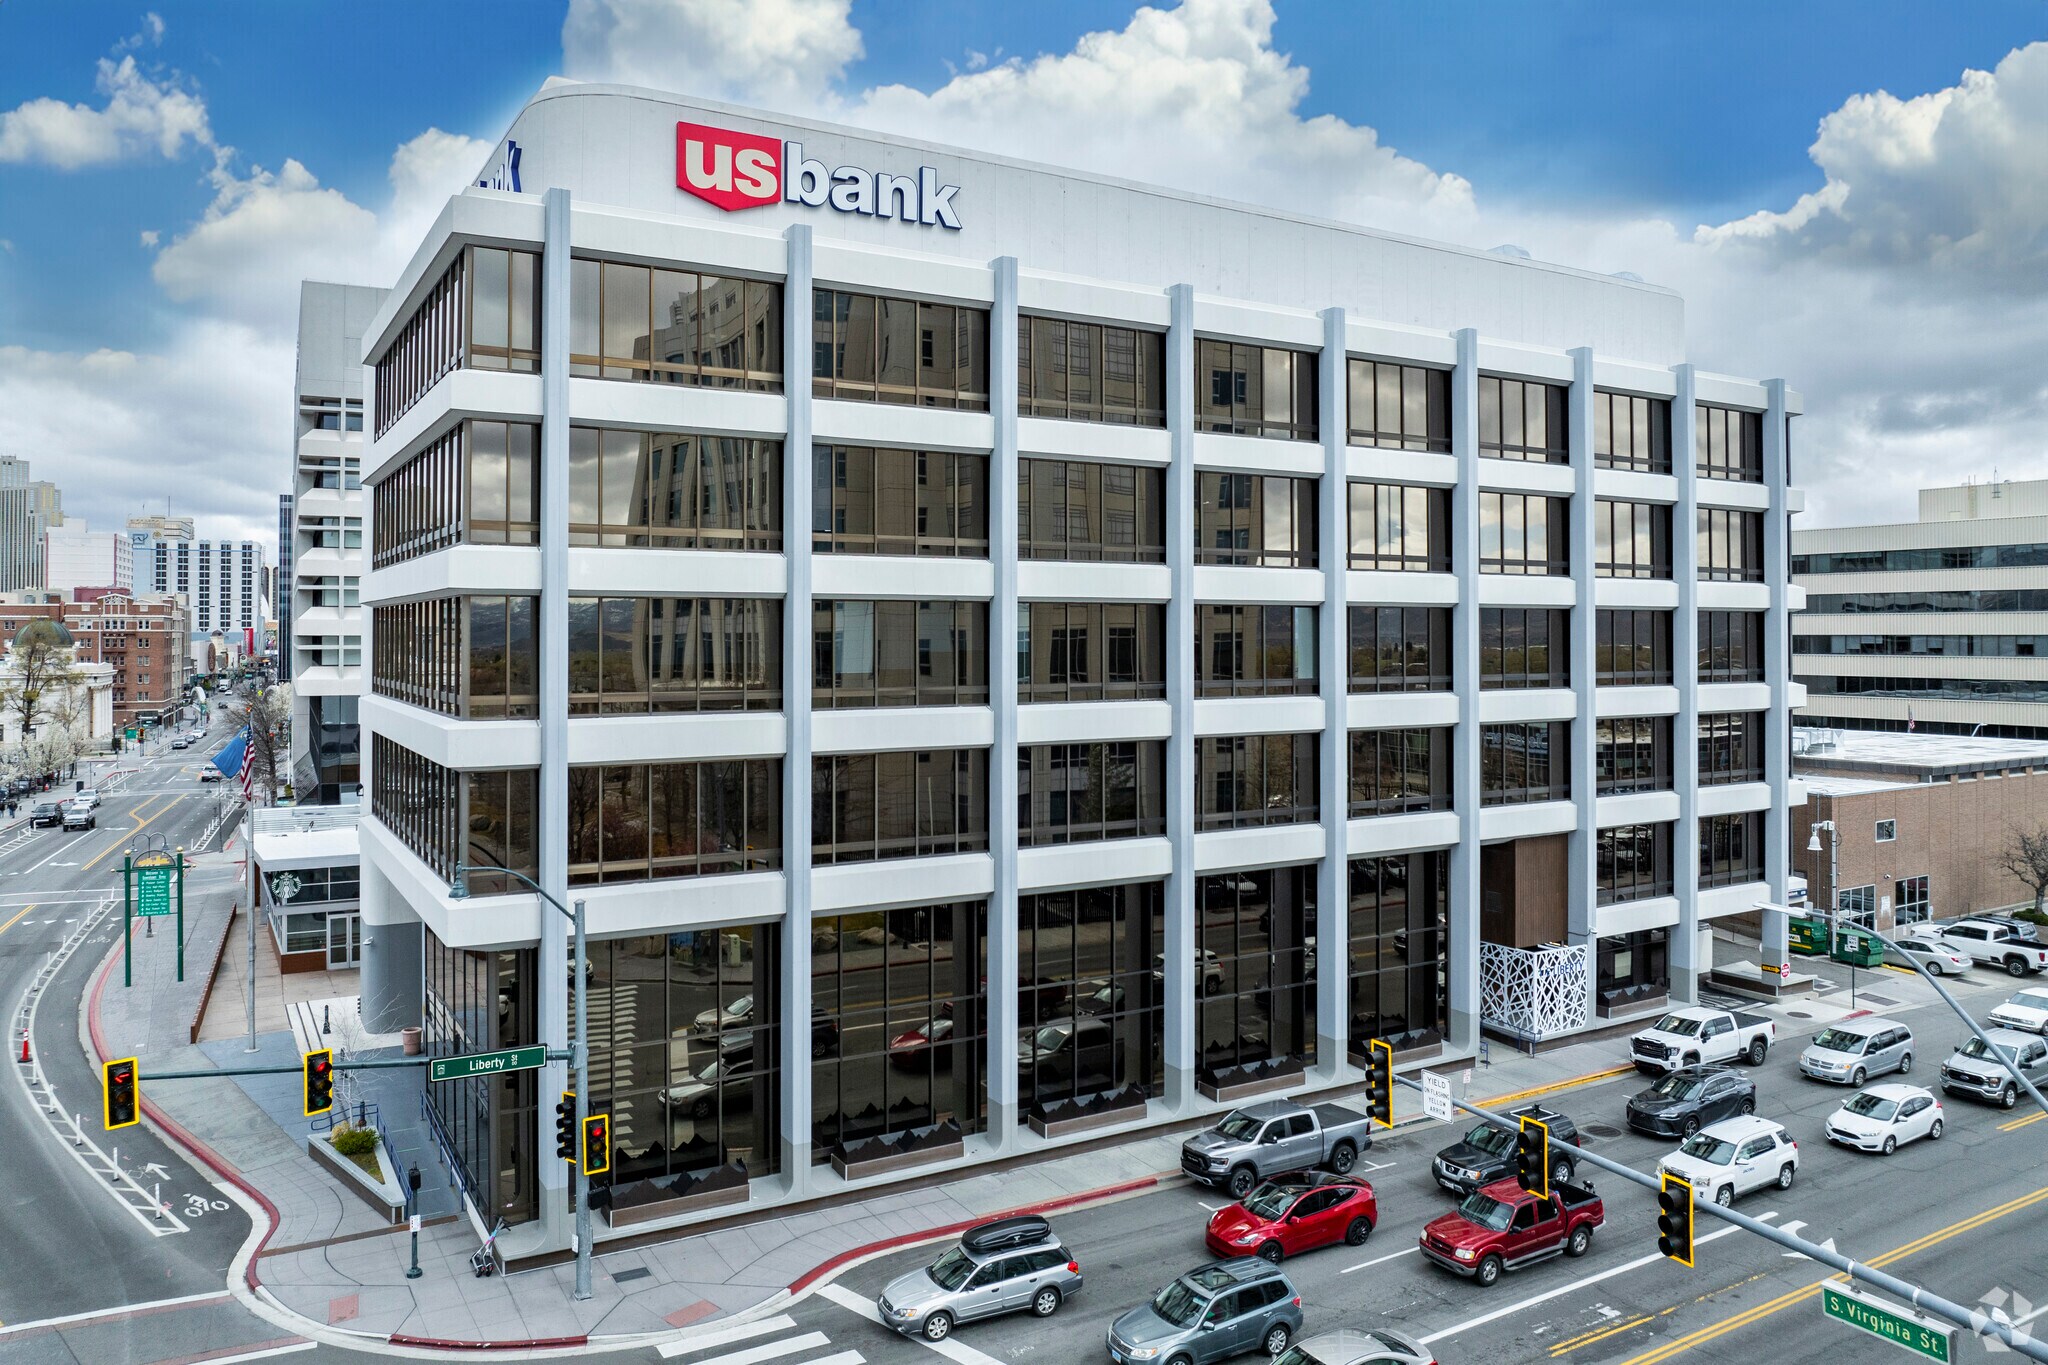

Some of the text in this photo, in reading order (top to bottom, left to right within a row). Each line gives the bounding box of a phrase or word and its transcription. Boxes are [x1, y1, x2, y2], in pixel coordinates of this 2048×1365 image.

[1553, 959, 1584, 976] LIBERTY
[469, 1057, 506, 1072] Liberty
[1427, 1076, 1446, 1089] YIELD
[1430, 1088, 1450, 1101] FLASHING
[1428, 1097, 1446, 1107] YELLOW
[1430, 1106, 1446, 1116] ARROW
[1846, 1301, 1911, 1342] Virginia
[1920, 1331, 1943, 1355] St.
